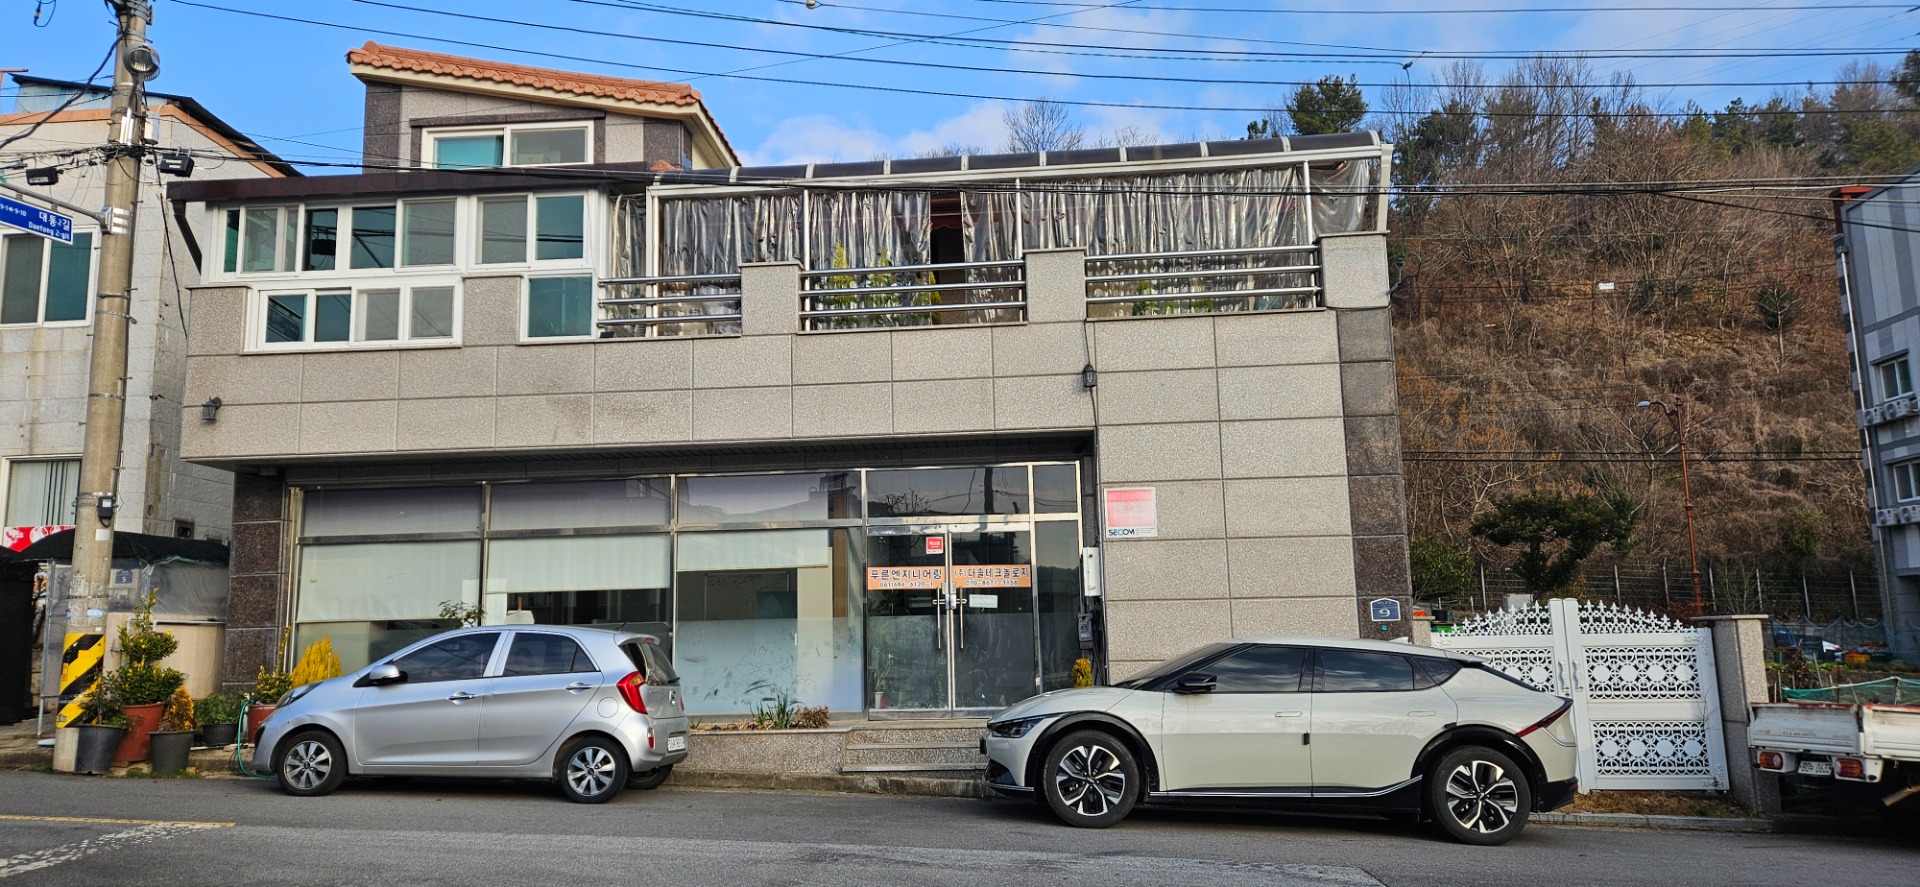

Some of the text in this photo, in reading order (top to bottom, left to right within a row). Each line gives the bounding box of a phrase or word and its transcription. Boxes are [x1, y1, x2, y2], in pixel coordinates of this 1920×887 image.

[38, 212, 70, 231] 대통2길
[28, 222, 54, 236] Daetong
[1108, 528, 1134, 536] SECOM
[870, 568, 942, 580] 푸른엔지니어링
[1380, 608, 1390, 618] 9
